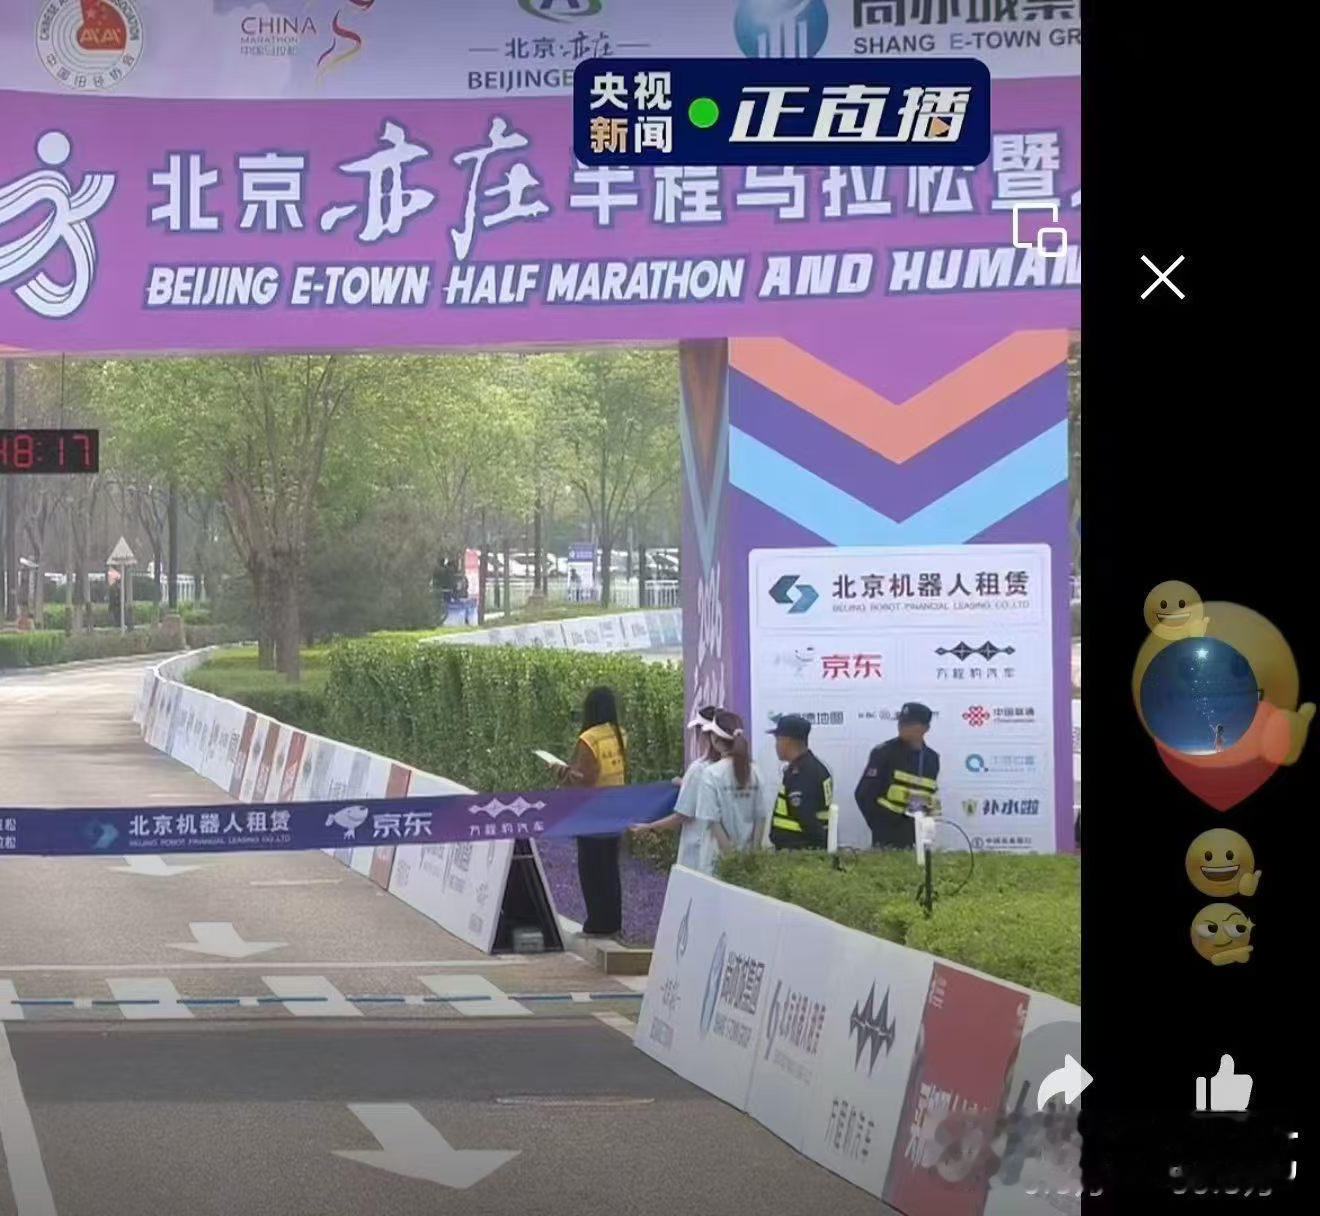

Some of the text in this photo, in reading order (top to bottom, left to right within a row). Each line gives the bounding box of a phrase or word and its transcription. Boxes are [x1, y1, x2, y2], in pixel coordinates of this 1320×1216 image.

[241, 16, 317, 35] CHINA
[854, 35, 935, 54] SHANG
[950, 31, 1041, 49] E-TOWN
[151, 117, 1080, 260] 北京亦庄半程马拉松暨
[146, 266, 278, 305] BEIJING
[291, 265, 430, 305] E-TOWN
[443, 263, 540, 304] HALF
[546, 258, 745, 303] MARATHON
[759, 252, 873, 296] AND
[832, 571, 1029, 599] 北京机器人租赁
[821, 654, 883, 679] 京东
[129, 811, 291, 836] 北京机器人租赁
[373, 812, 433, 838] 京东
